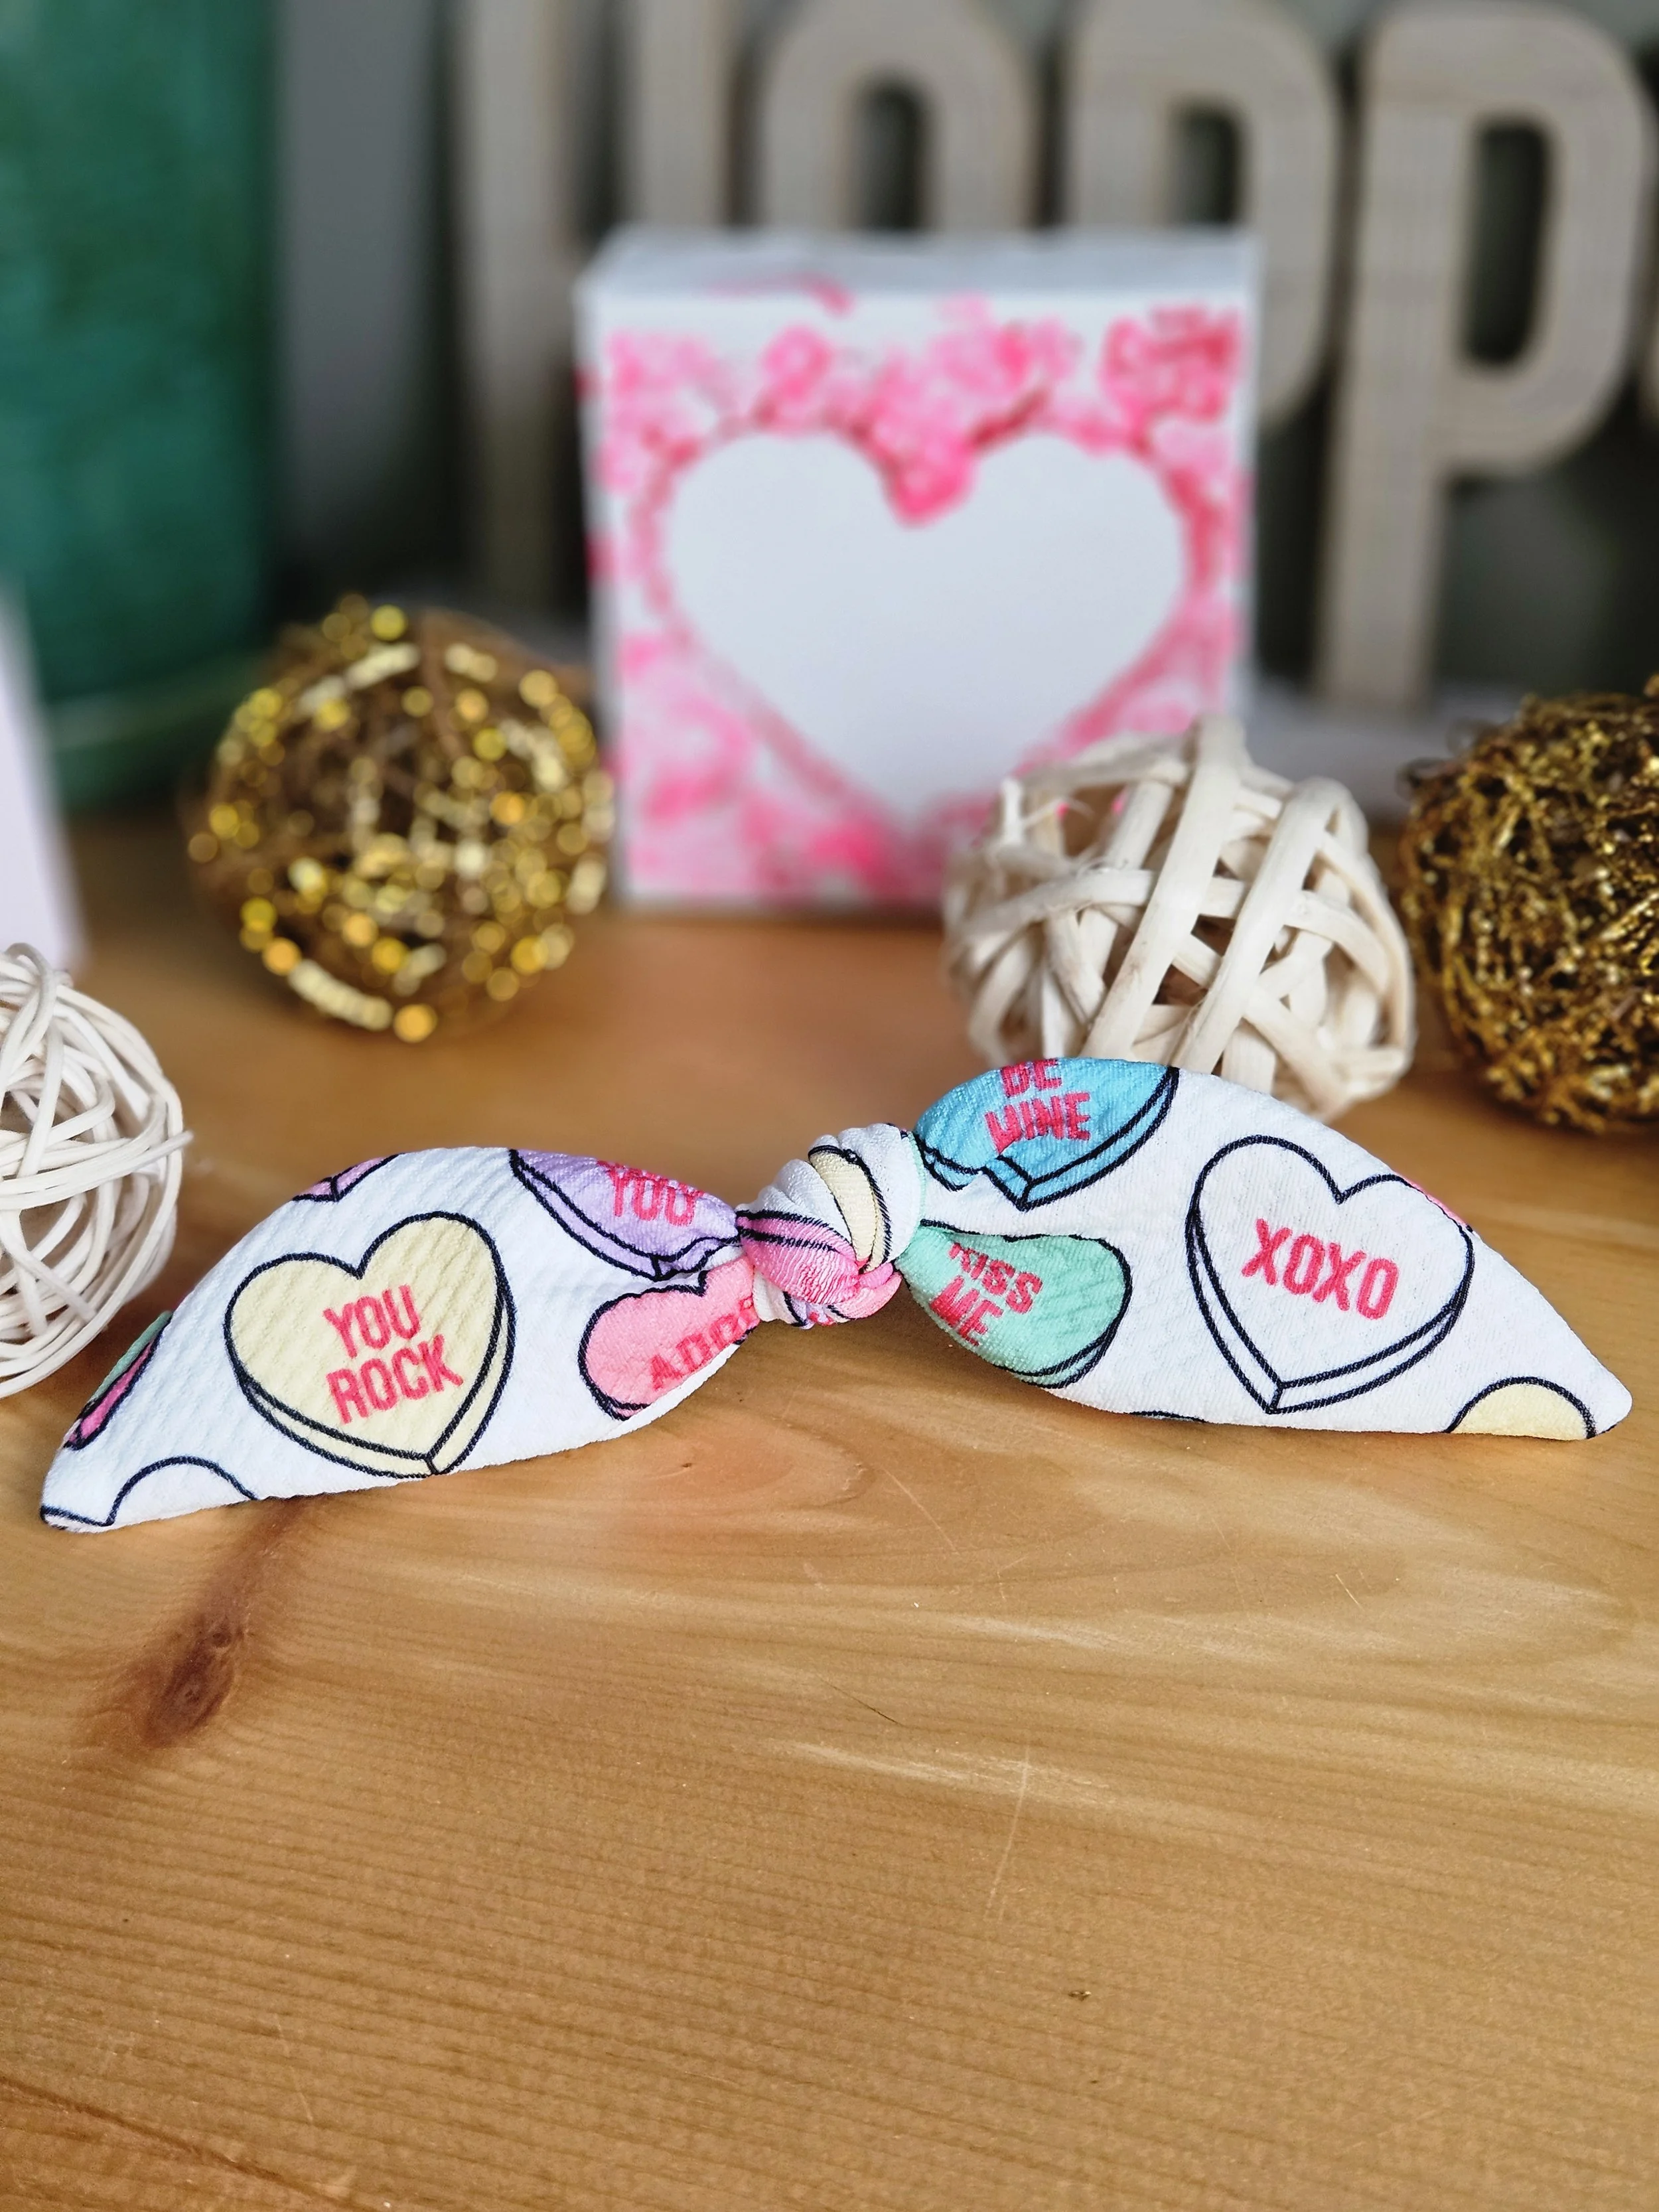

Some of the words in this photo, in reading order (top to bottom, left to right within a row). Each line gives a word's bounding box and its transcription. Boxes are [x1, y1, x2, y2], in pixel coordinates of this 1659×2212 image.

[1242, 1218, 1398, 1320] XOXO
[323, 1285, 420, 1357] YOU
[326, 1335, 463, 1424] ROCK
